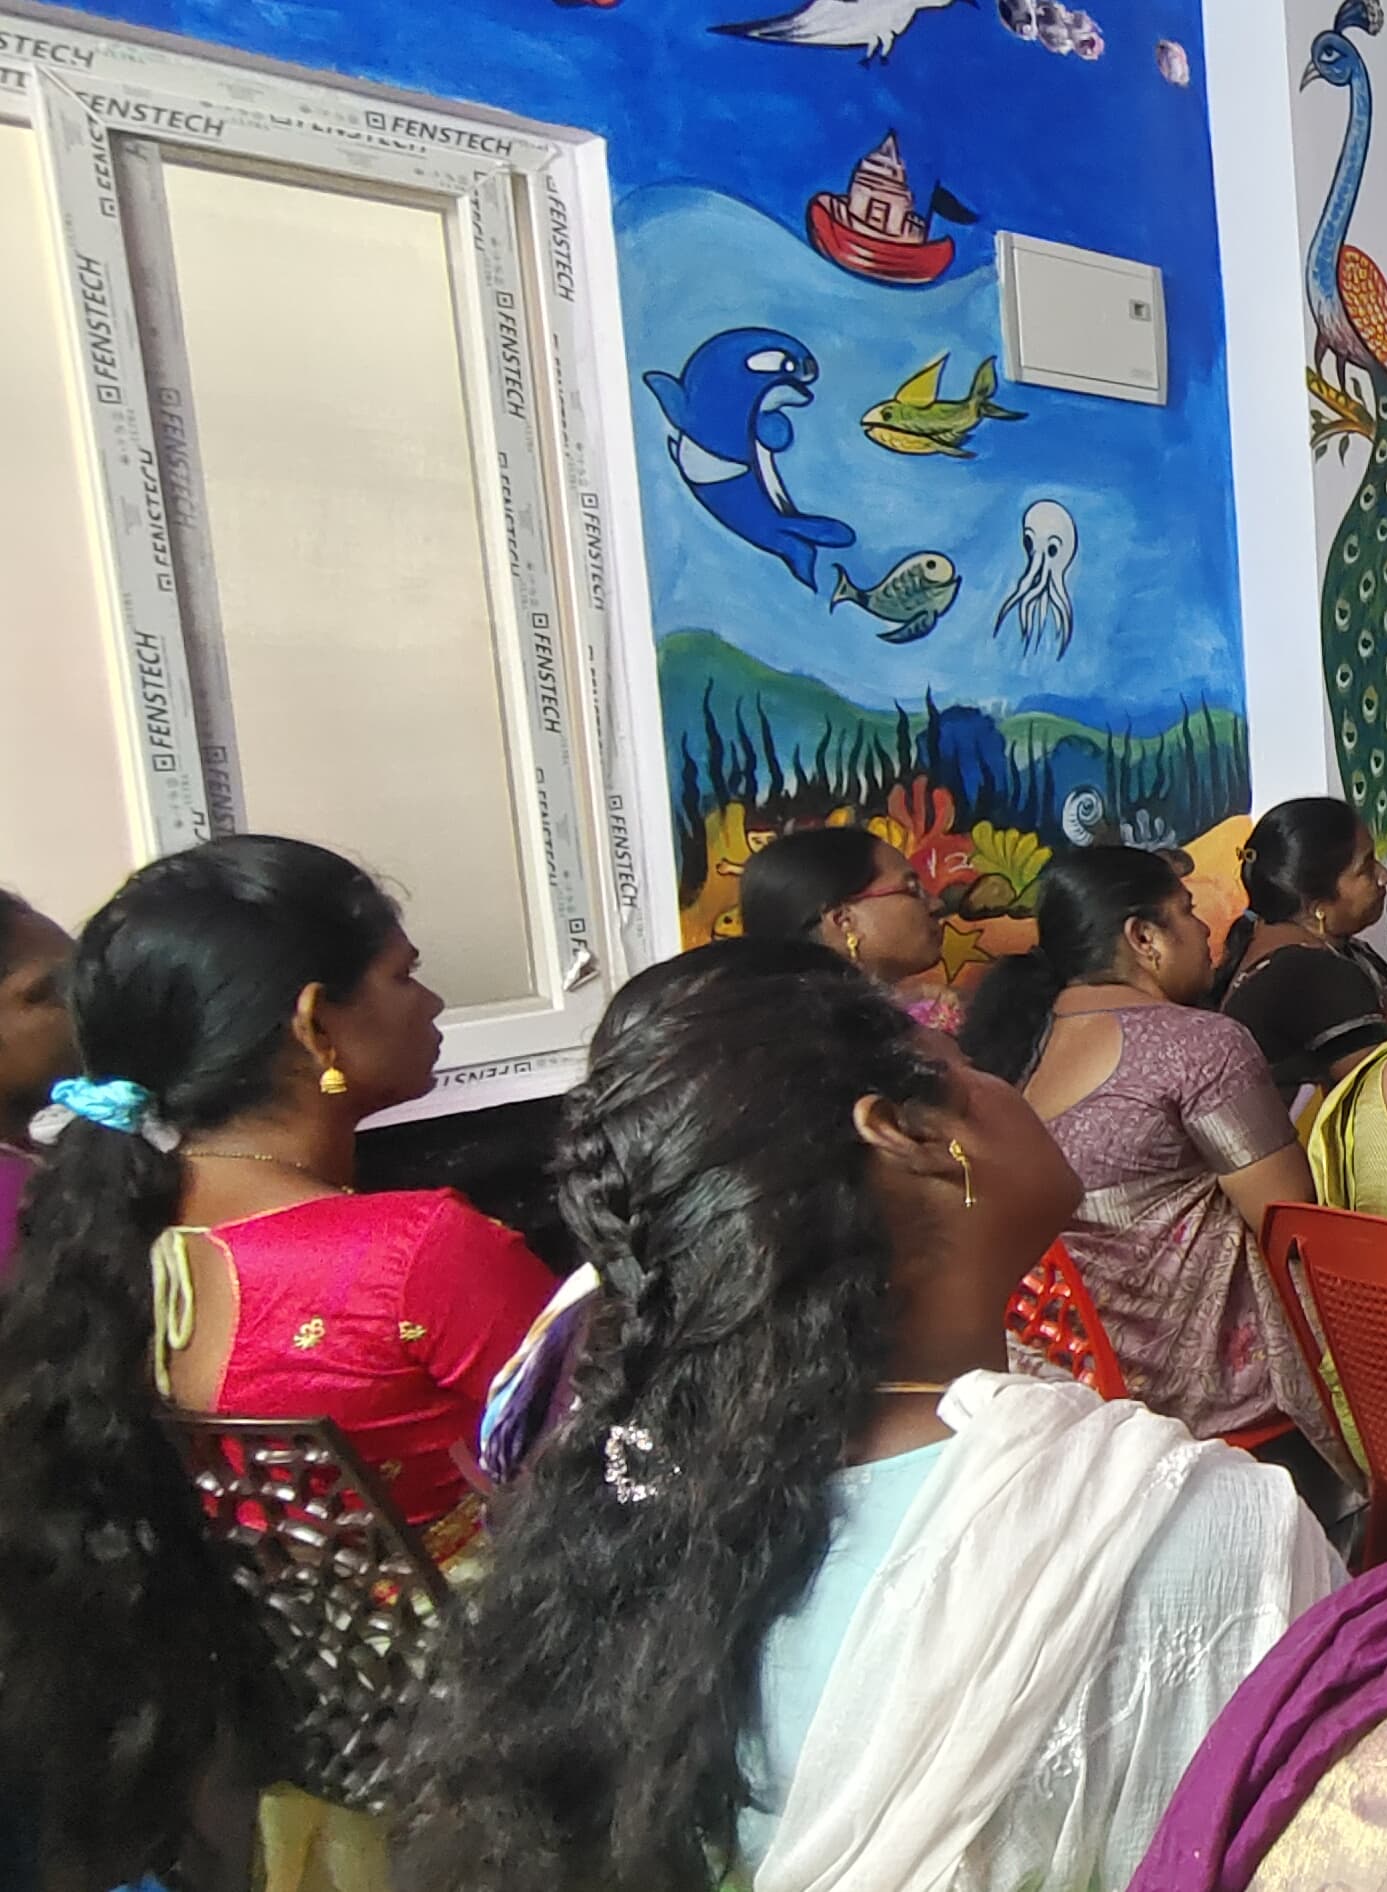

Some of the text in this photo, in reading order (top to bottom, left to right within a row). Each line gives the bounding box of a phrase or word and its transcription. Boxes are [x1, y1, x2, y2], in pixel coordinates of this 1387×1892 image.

[391, 117, 512, 156] FENSTECH
[550, 191, 575, 302] FENSTECH
[76, 253, 118, 381] FENSTECH
[498, 310, 526, 419] FENSTECH
[583, 511, 605, 610] FENSTECH
[133, 631, 171, 749] FENSTECH
[534, 632, 562, 733] FENSTECH
[610, 813, 638, 908] FENSTECH
